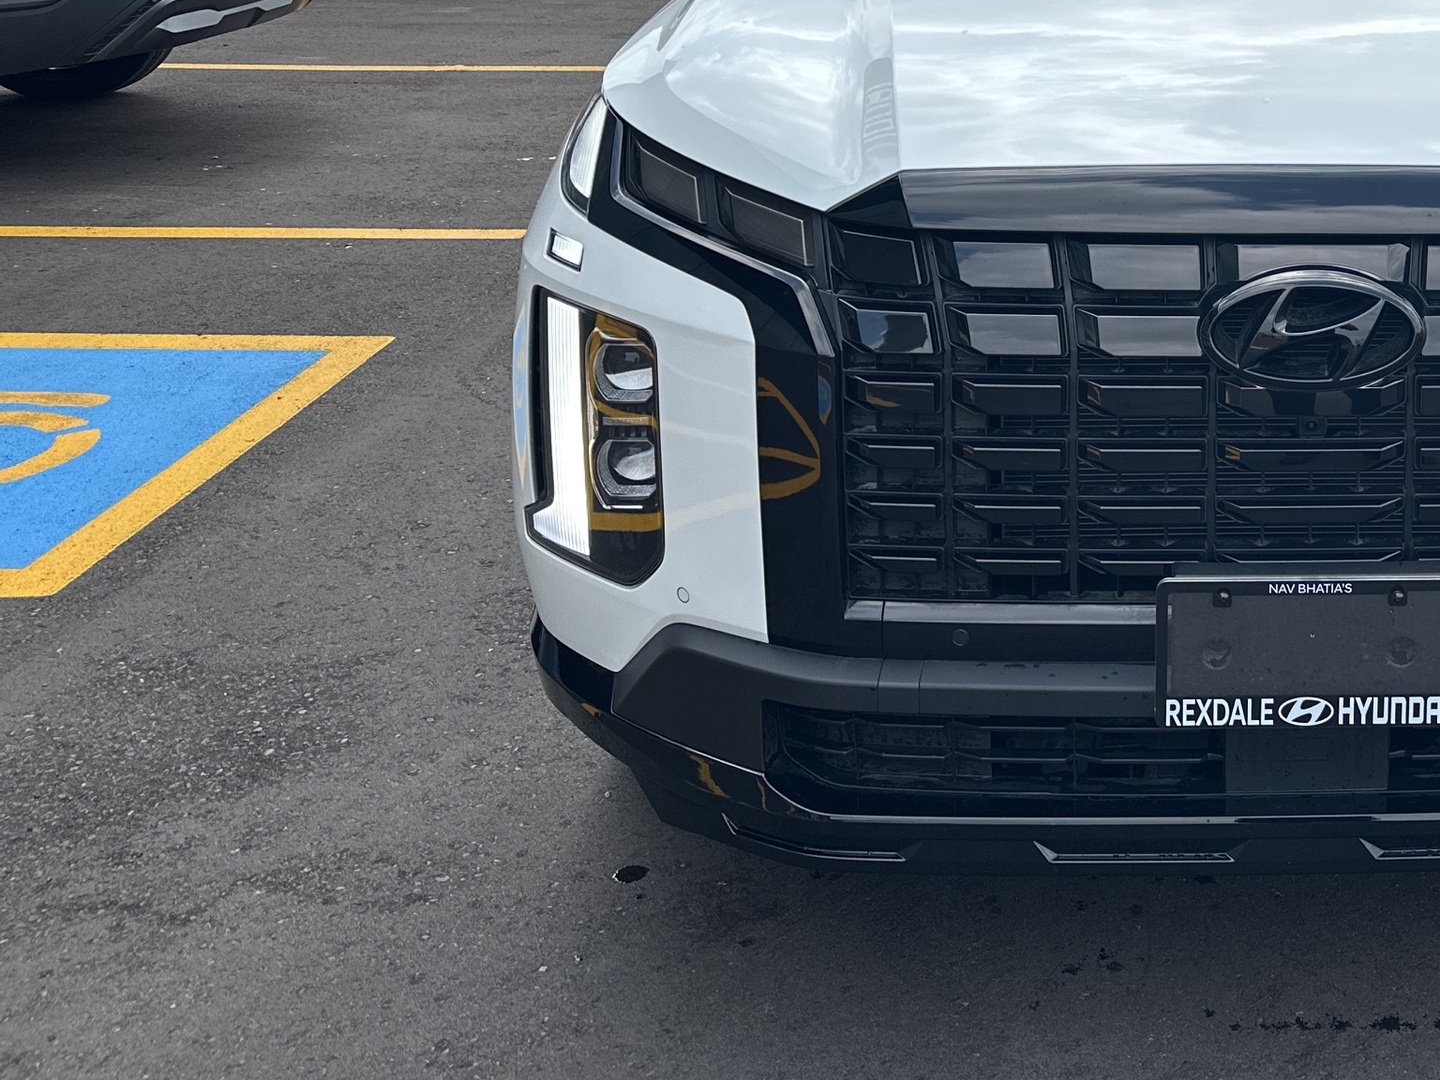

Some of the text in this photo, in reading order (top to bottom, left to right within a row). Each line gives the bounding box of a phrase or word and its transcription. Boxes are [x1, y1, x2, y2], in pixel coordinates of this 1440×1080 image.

[1268, 583, 1353, 594] NAV BHATIA'S
[1165, 698, 1274, 726] REXDALE
